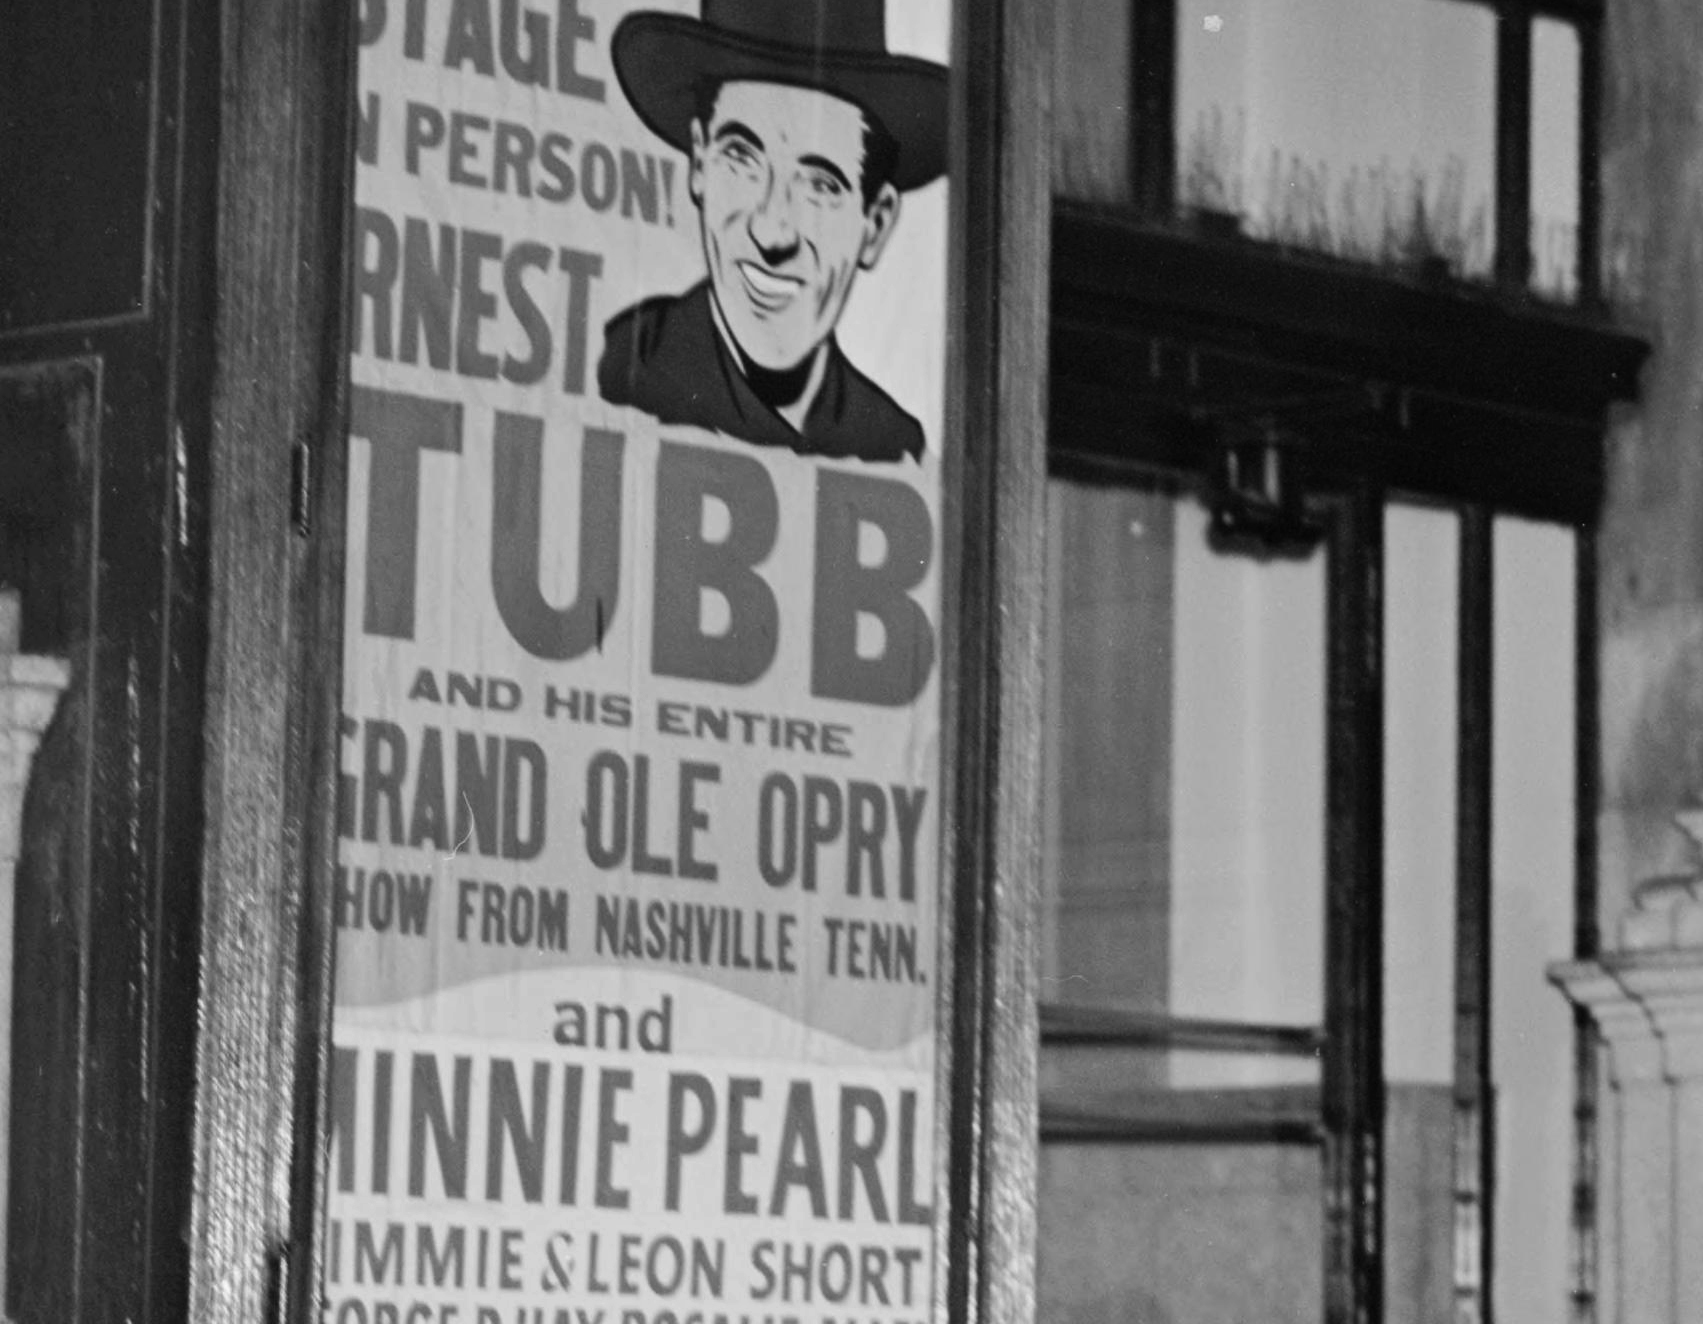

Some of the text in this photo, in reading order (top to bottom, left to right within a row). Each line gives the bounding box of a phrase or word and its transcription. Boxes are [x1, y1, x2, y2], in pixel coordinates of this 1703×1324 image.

[404, 100, 676, 229] PERSON!
[352, 205, 604, 396] RNEST
[348, 384, 936, 710] TUBB
[408, 668, 855, 759] AND HIS ENTIRE
[583, 749, 722, 882] OLE
[758, 771, 928, 903] OPRY
[336, 866, 928, 985] HOW FROM NASHVILLE TENN.
[553, 993, 674, 1055] and
[664, 1071, 936, 1227] PEARL
[329, 1217, 525, 1291] IMMIE
[749, 1238, 923, 1307] SHORT
